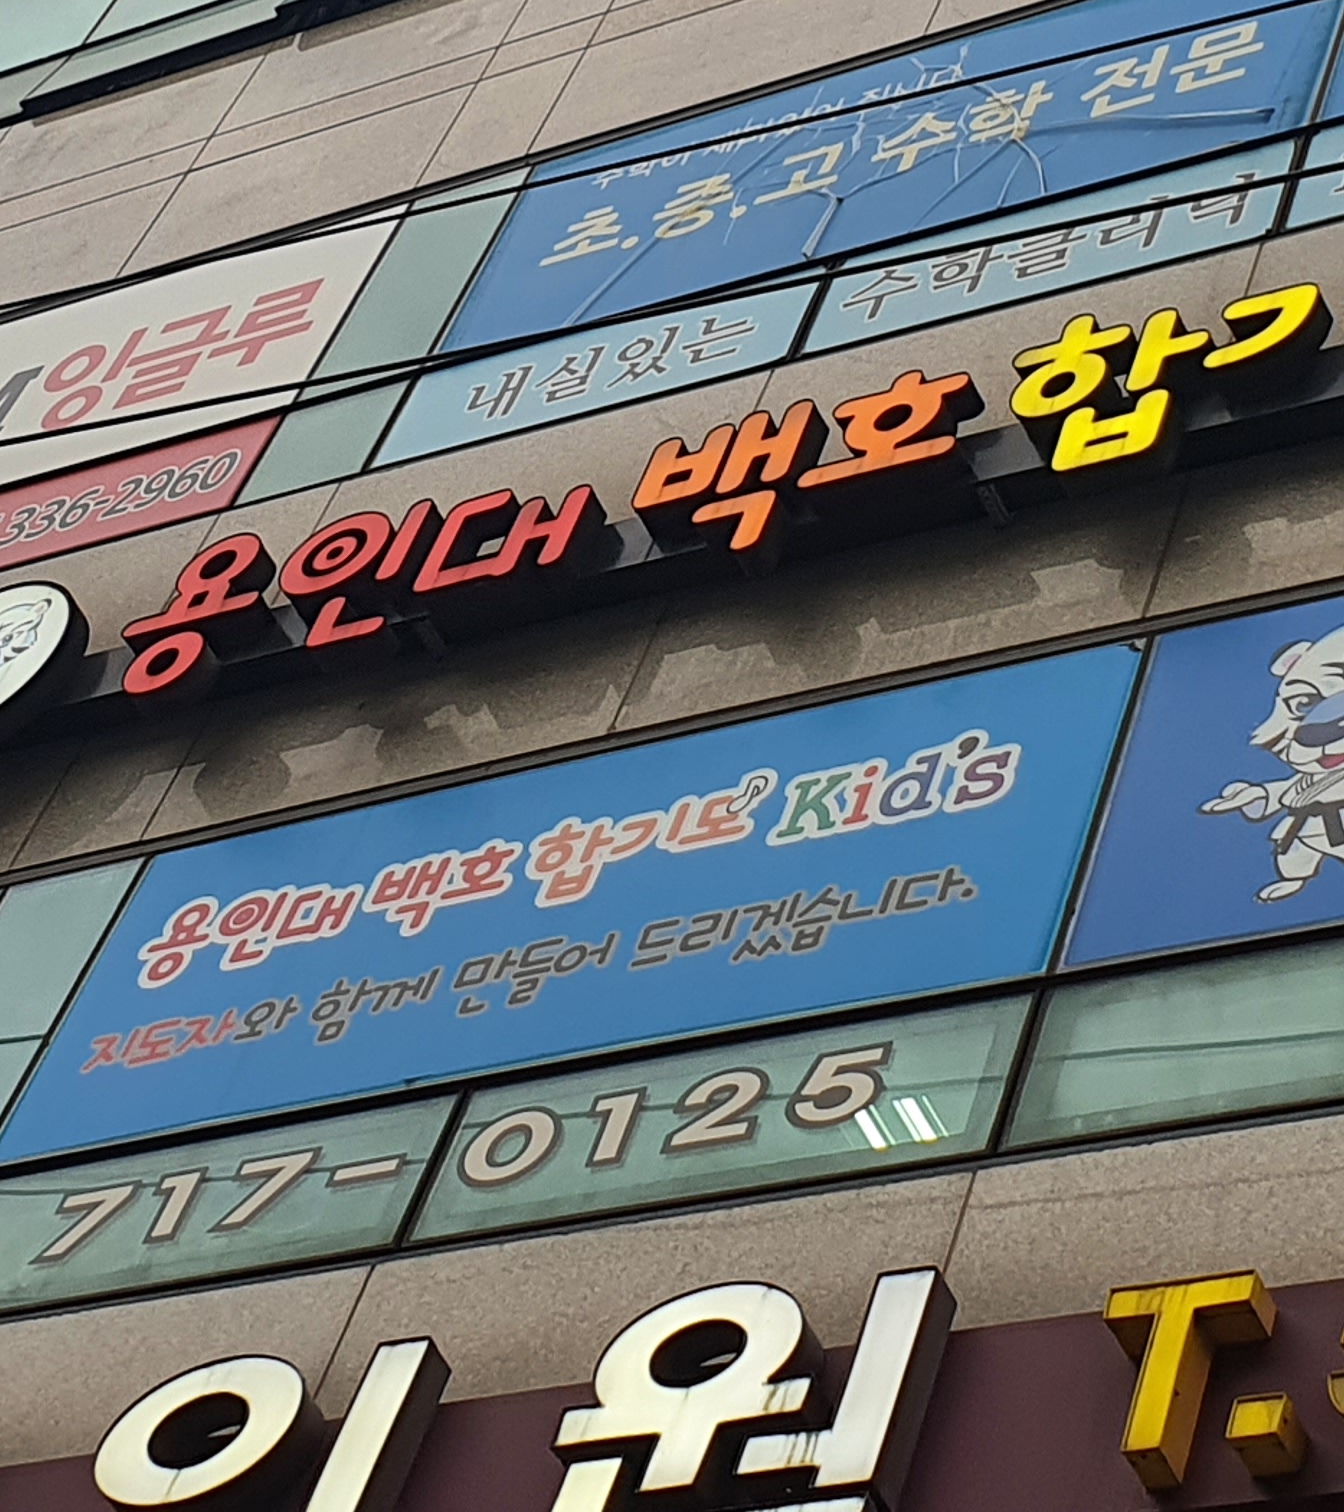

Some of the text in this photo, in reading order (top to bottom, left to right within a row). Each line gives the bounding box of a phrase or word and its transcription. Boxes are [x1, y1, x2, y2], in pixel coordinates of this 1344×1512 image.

[871, 80, 1054, 174] 수학
[1080, 21, 1265, 119] 전문
[465, 312, 757, 422] 내실있는
[121, 485, 594, 696] 용인대
[632, 369, 972, 554] 백호
[136, 728, 1021, 989] 용인대 백호 합기도 Kid's
[83, 864, 980, 1074] 지도자와 함께 만들어 드리겠습니다.
